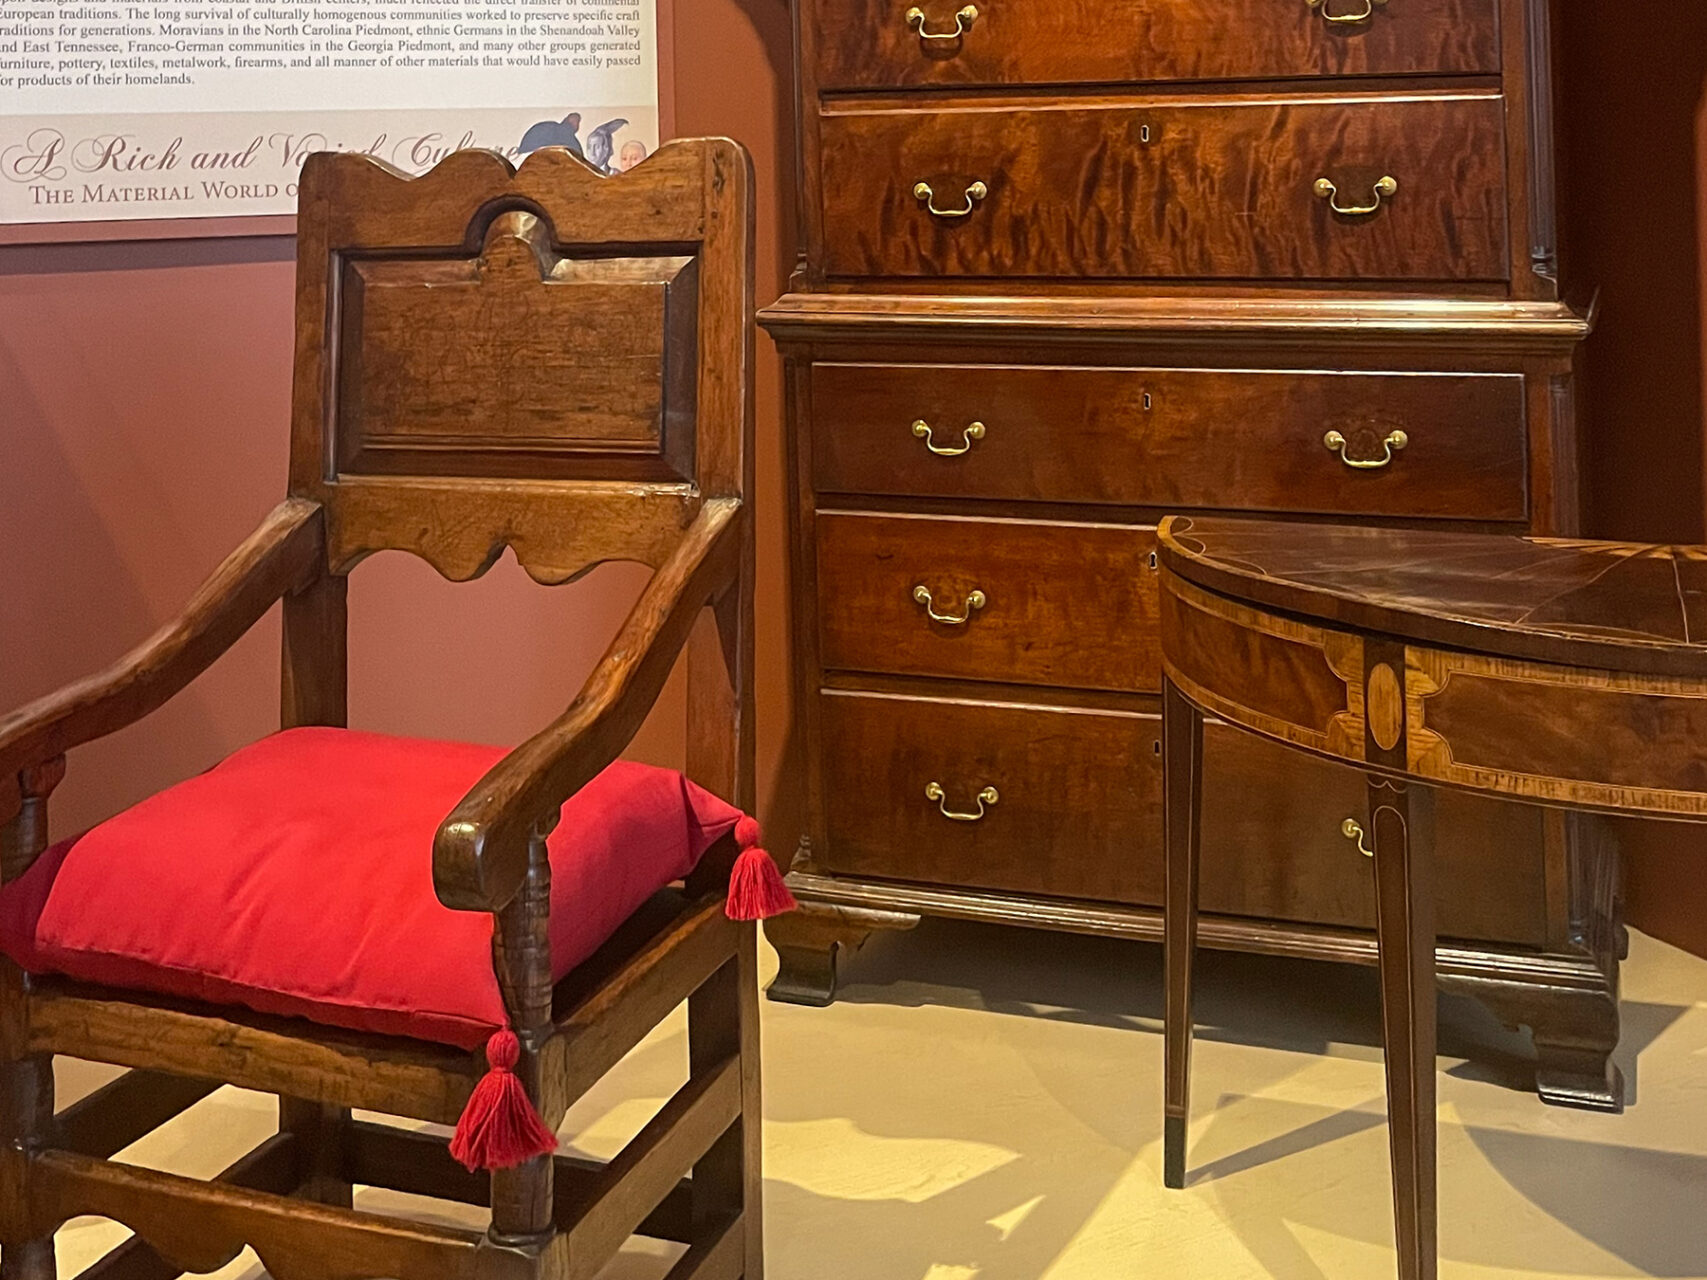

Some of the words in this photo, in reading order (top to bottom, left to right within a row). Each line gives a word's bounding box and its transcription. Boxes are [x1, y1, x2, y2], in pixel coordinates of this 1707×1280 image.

[17, 73, 72, 89] products
[75, 73, 90, 85] of
[92, 72, 121, 85] their
[125, 72, 194, 85] homelands.
[1, 127, 67, 183] A
[71, 133, 180, 173] Rich
[190, 136, 263, 170] and
[29, 185, 73, 204] THE
[83, 183, 193, 202] MATERIAL
[203, 180, 278, 198] WORLD
[286, 183, 299, 198] O
